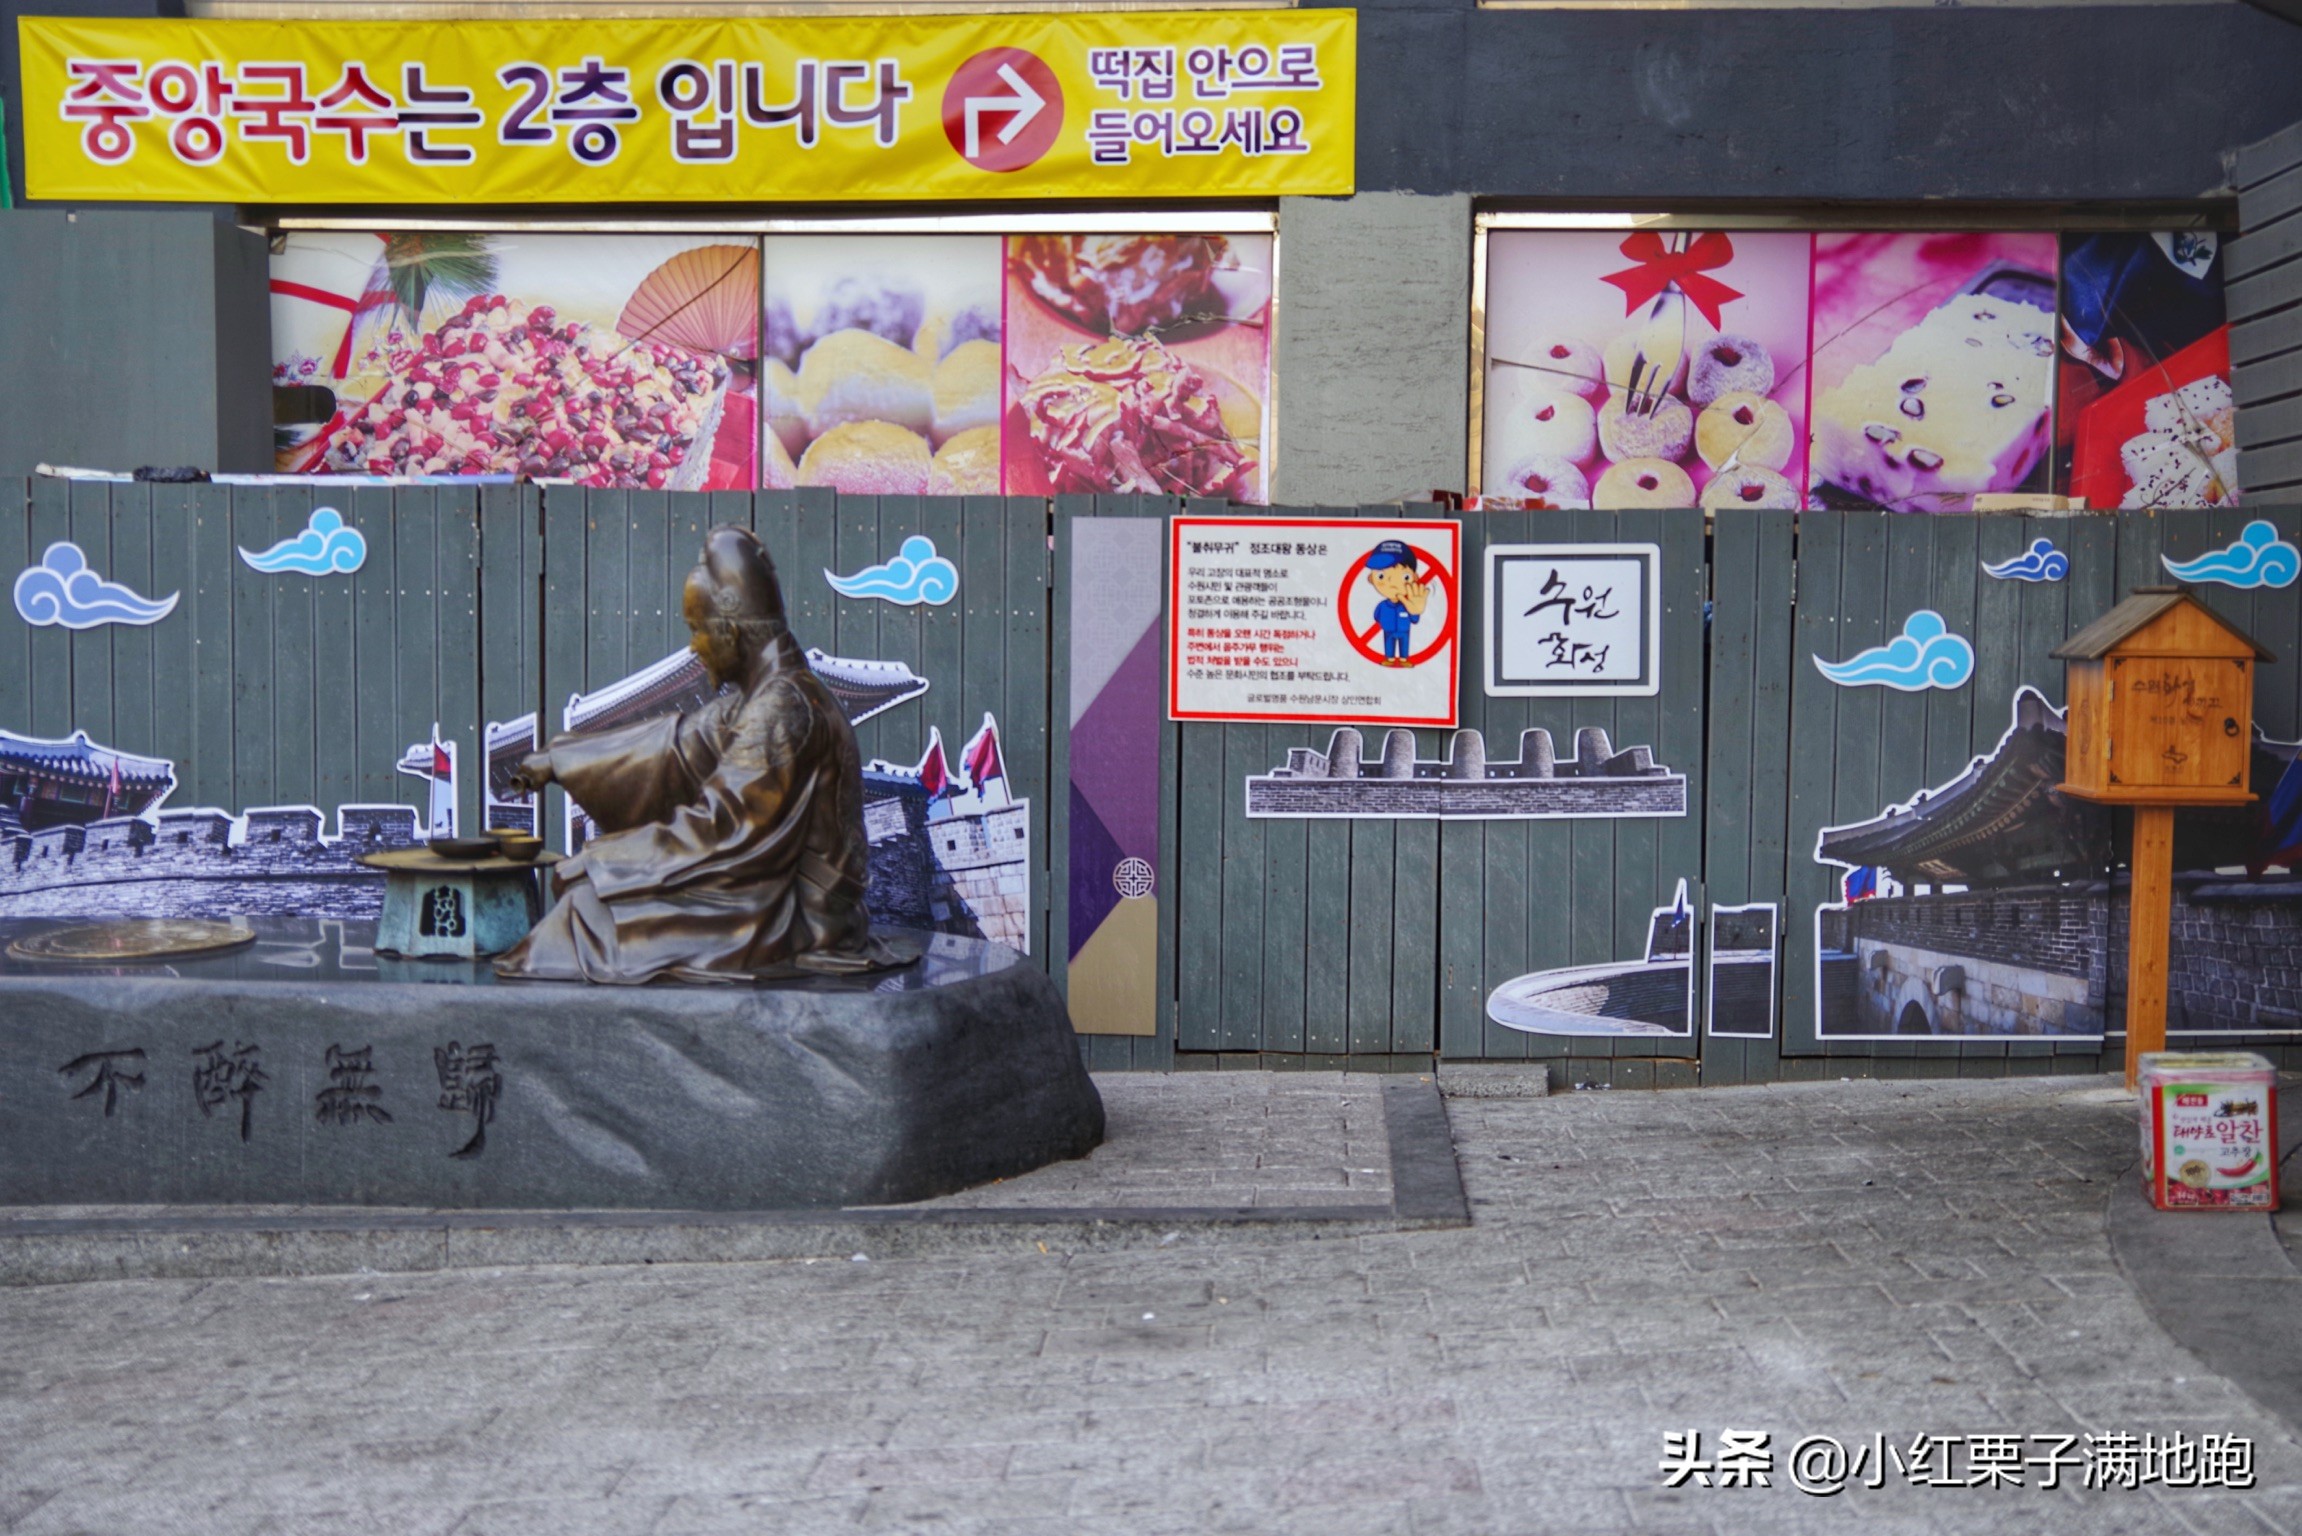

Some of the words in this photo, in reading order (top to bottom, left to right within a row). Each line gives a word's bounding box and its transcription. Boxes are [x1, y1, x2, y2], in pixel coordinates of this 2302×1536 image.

[1091, 49, 1174, 99] 떡집
[1187, 47, 1321, 97] 안으로
[63, 60, 482, 164] 중앙국수는
[500, 59, 639, 164] 2층
[659, 61, 910, 161] 입니다
[1088, 109, 1308, 164] 들어오세요
[1250, 543, 1293, 555] 정조대왕
[1296, 543, 1328, 555] 동상은
[1523, 568, 1620, 626] 수원
[1537, 632, 1610, 674] 화성
